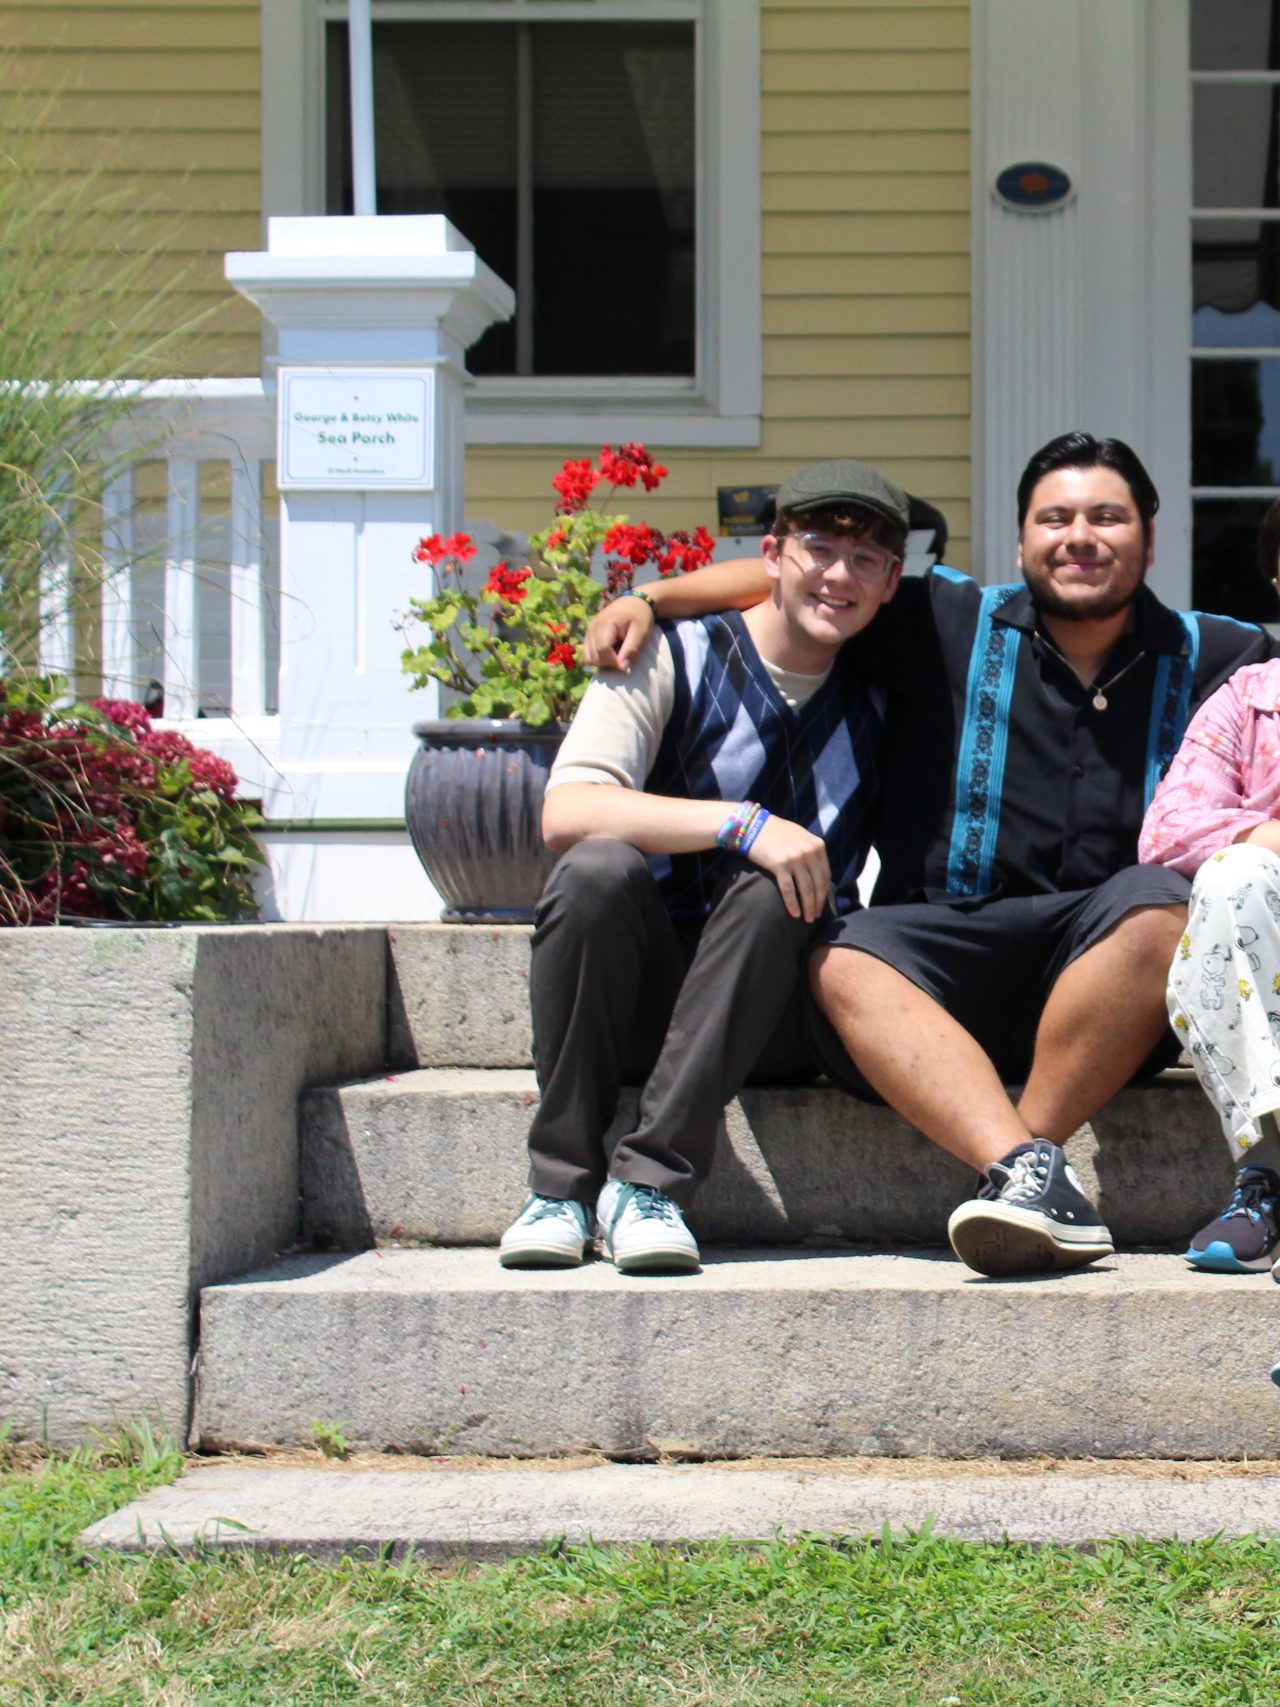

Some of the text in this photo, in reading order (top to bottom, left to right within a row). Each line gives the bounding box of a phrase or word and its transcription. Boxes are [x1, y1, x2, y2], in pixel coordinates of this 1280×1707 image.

[294, 412, 419, 425] George & Betsy White
[318, 430, 395, 443] Sea Porch
